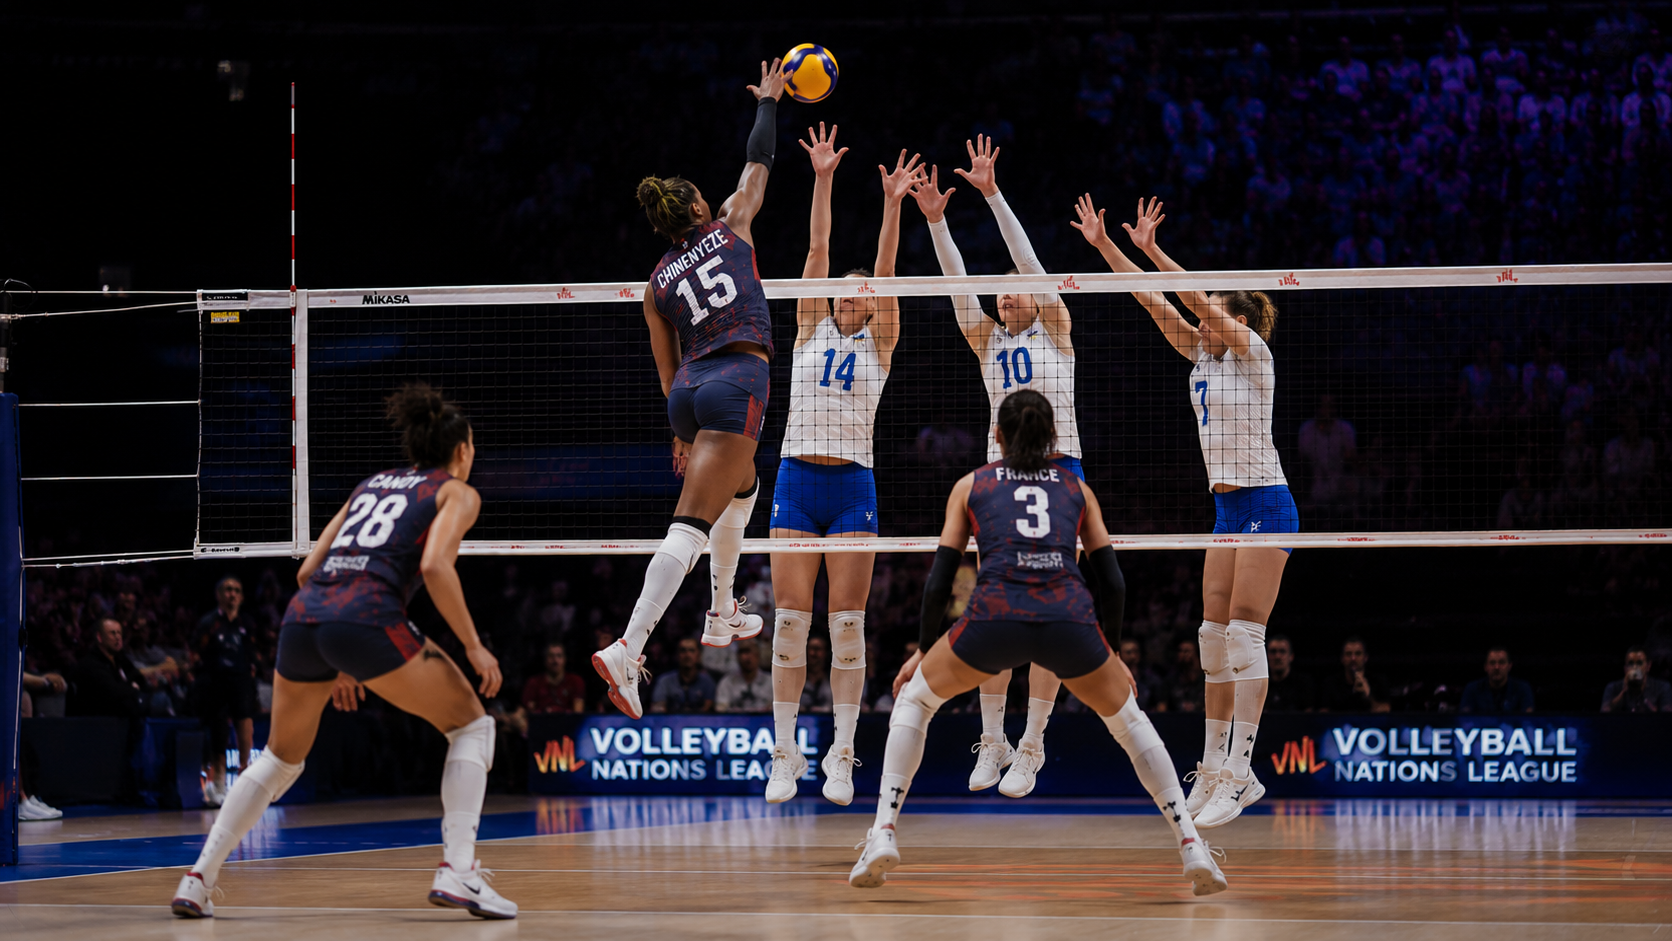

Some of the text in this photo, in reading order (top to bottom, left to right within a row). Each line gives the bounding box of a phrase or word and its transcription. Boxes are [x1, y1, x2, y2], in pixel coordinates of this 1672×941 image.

[657, 229, 729, 289] CHINENYEZE
[676, 255, 738, 327] 15
[819, 348, 857, 391] 14
[996, 347, 1032, 389] 10
[1195, 380, 1208, 427] 7
[330, 493, 408, 549] 28
[1013, 485, 1051, 538] 3
[533, 735, 586, 774] VNL
[590, 727, 818, 755] VOLLEYBAL
[1271, 735, 1327, 775] VNL
[1332, 727, 1578, 756] VOLLEYBALL
[592, 759, 818, 781] NATIONS LEAE
[1334, 760, 1578, 782] NATIONS LEAGUE
